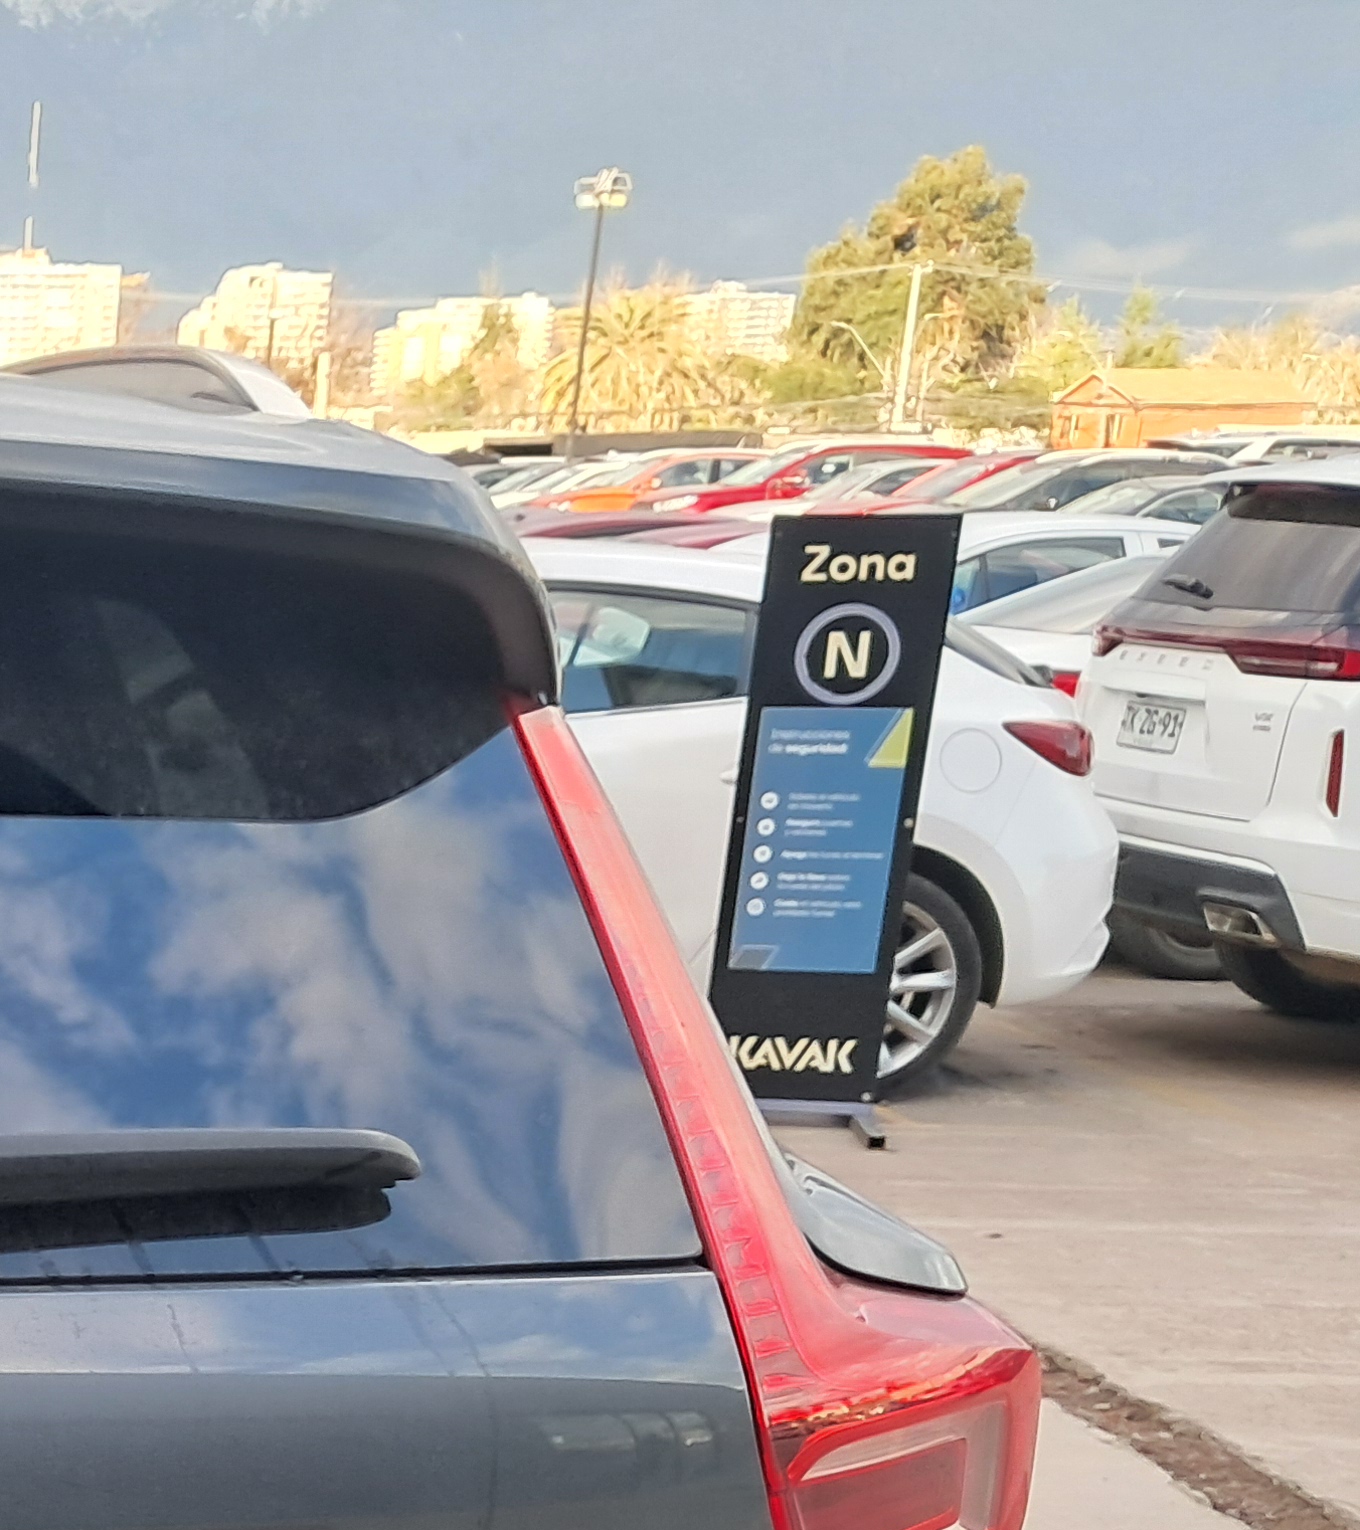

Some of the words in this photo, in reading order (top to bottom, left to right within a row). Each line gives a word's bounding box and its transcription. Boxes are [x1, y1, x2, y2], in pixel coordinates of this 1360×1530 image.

[800, 544, 917, 582] Zona
[823, 629, 873, 679] N
[729, 1034, 859, 1074] KAVAK
